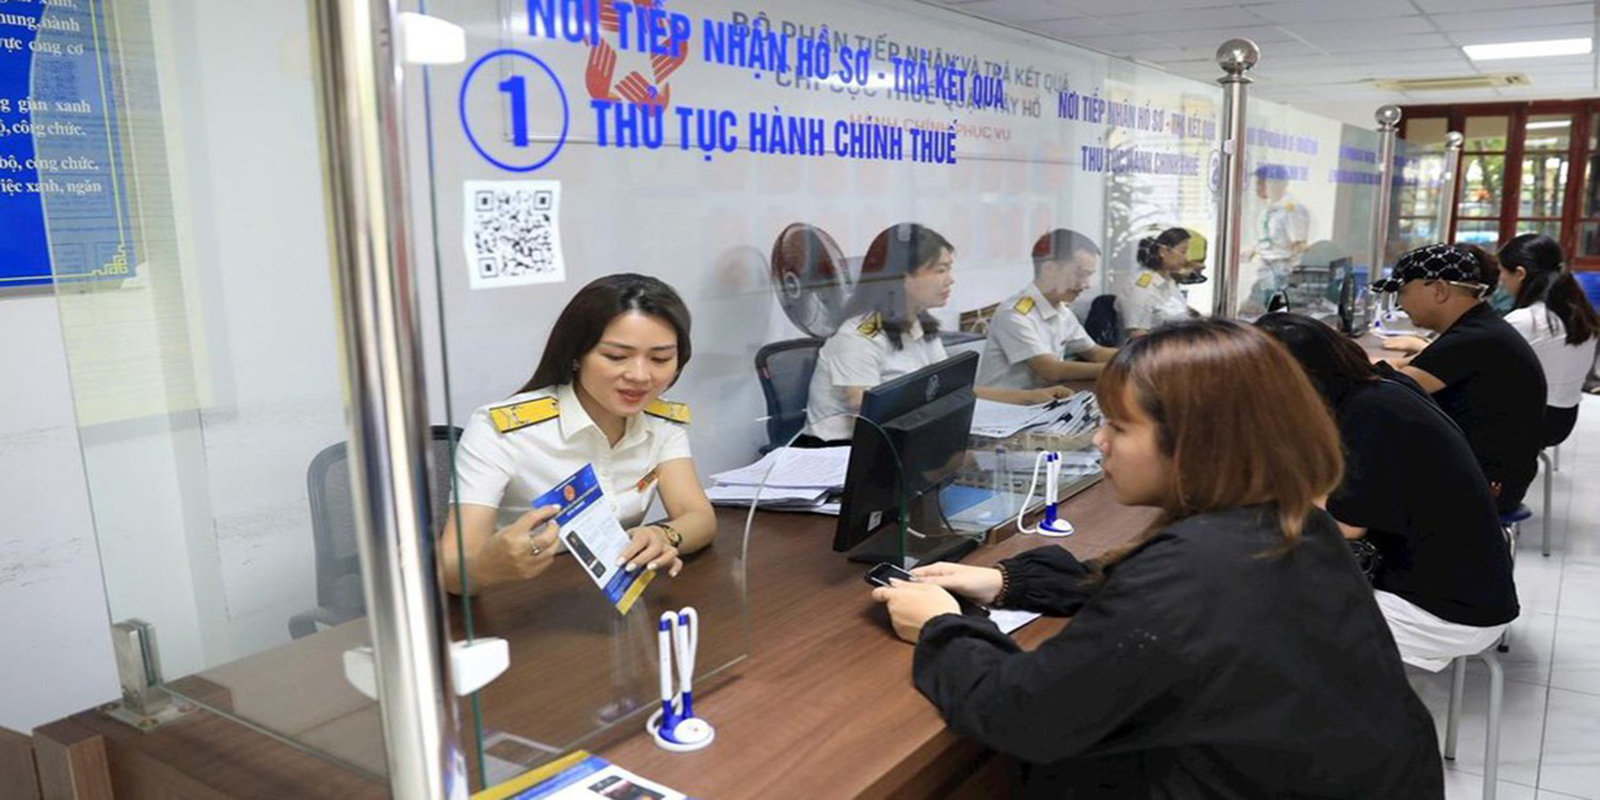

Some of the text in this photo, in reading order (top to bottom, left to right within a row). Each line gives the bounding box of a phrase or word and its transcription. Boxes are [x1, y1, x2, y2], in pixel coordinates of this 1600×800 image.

[613, 0, 691, 58] TIẾP
[703, 18, 787, 79] NHẬN
[796, 25, 831, 80] HỒ
[839, 46, 871, 86] SƠ
[498, 75, 529, 148] 1
[591, 85, 957, 165] THỦ TỤC HÀNH CHÍNH THUẾ
